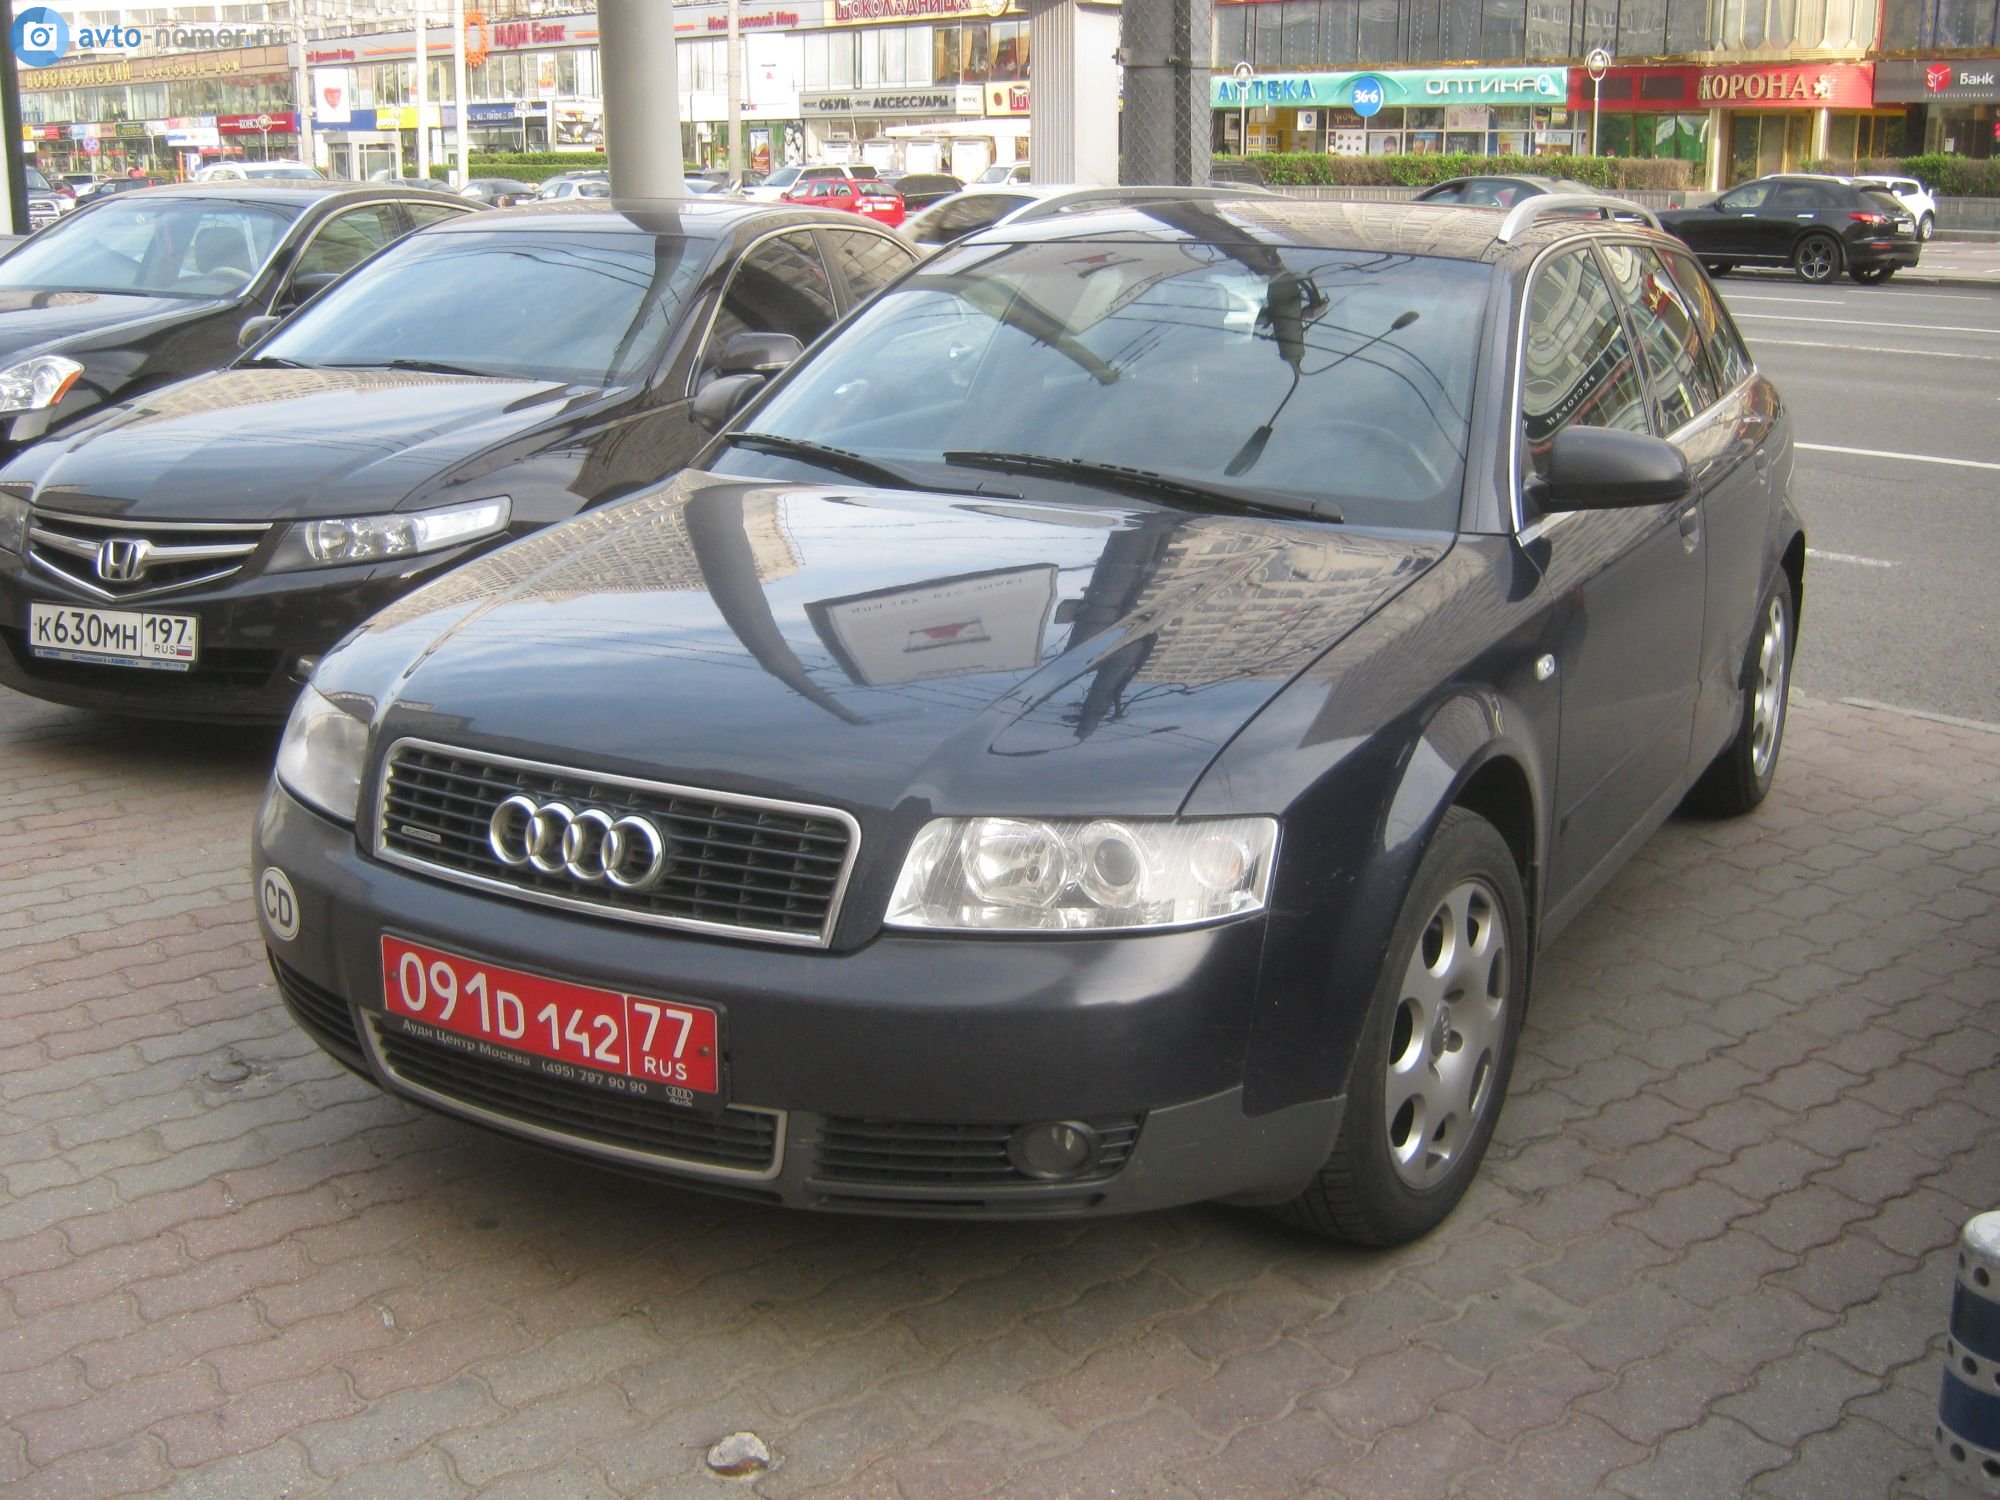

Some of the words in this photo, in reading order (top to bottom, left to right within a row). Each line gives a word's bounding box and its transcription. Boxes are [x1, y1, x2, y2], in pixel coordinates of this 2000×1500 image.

[494, 23, 529, 48] МДМ
[532, 21, 566, 43] Банк
[26, 60, 132, 89] НОВОАРБАТСКИЙ
[1426, 78, 1537, 94] ОПТИКА
[1699, 73, 1809, 99] КОРОНА
[1960, 72, 1994, 85] Банк
[873, 94, 948, 109] АКСЕССУАРЫ
[1218, 80, 1316, 100] АПТЕКА
[145, 617, 188, 644] 197
[154, 643, 176, 655] RUS
[265, 879, 293, 929] CD
[634, 1002, 693, 1059] 77
[402, 1018, 433, 1038] Ауди
[436, 1029, 476, 1053] Центр
[480, 1042, 531, 1066] Москва
[541, 1060, 575, 1080] (495)
[579, 1070, 604, 1085] 797
[608, 1077, 626, 1089] 90
[629, 1081, 647, 1094] 90
[644, 1056, 688, 1080] RUS
